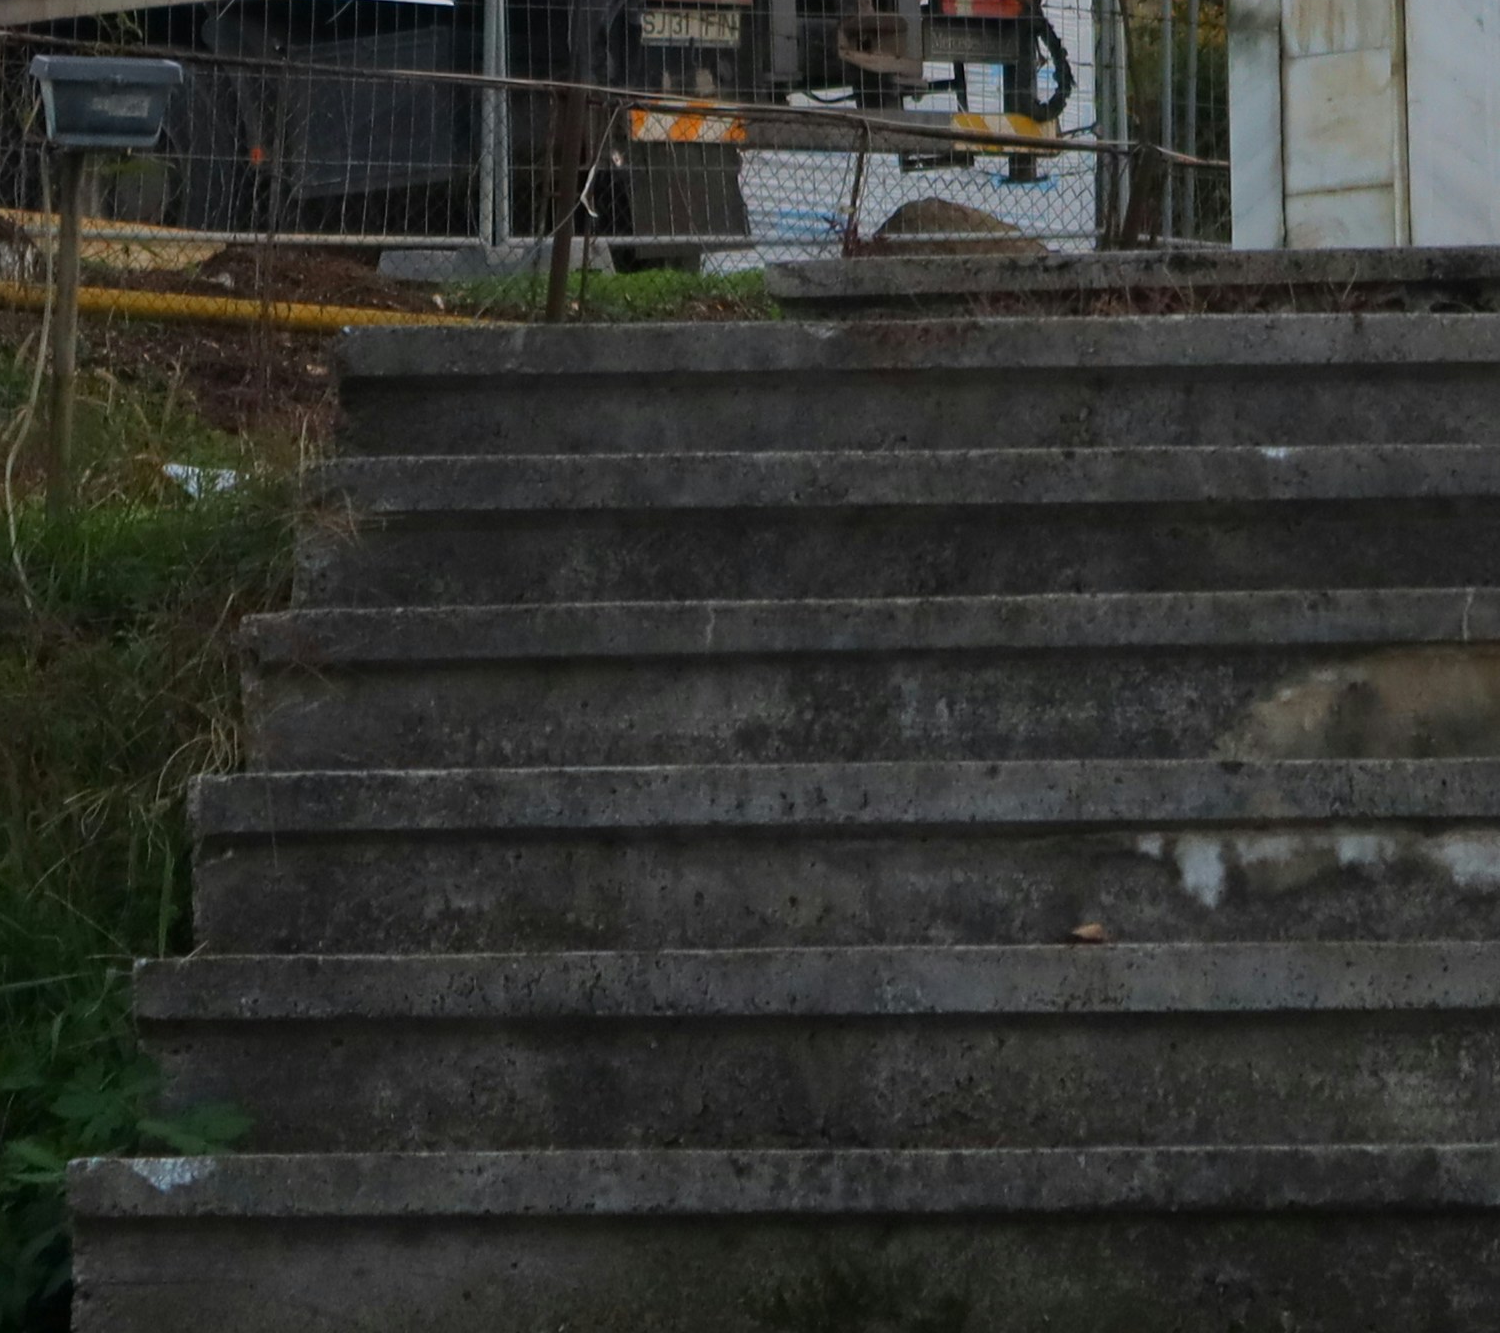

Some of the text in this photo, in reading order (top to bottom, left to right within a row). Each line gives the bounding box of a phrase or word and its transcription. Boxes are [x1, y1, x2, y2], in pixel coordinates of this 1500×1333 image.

[642, 12, 738, 35] SJ 31 FIN
